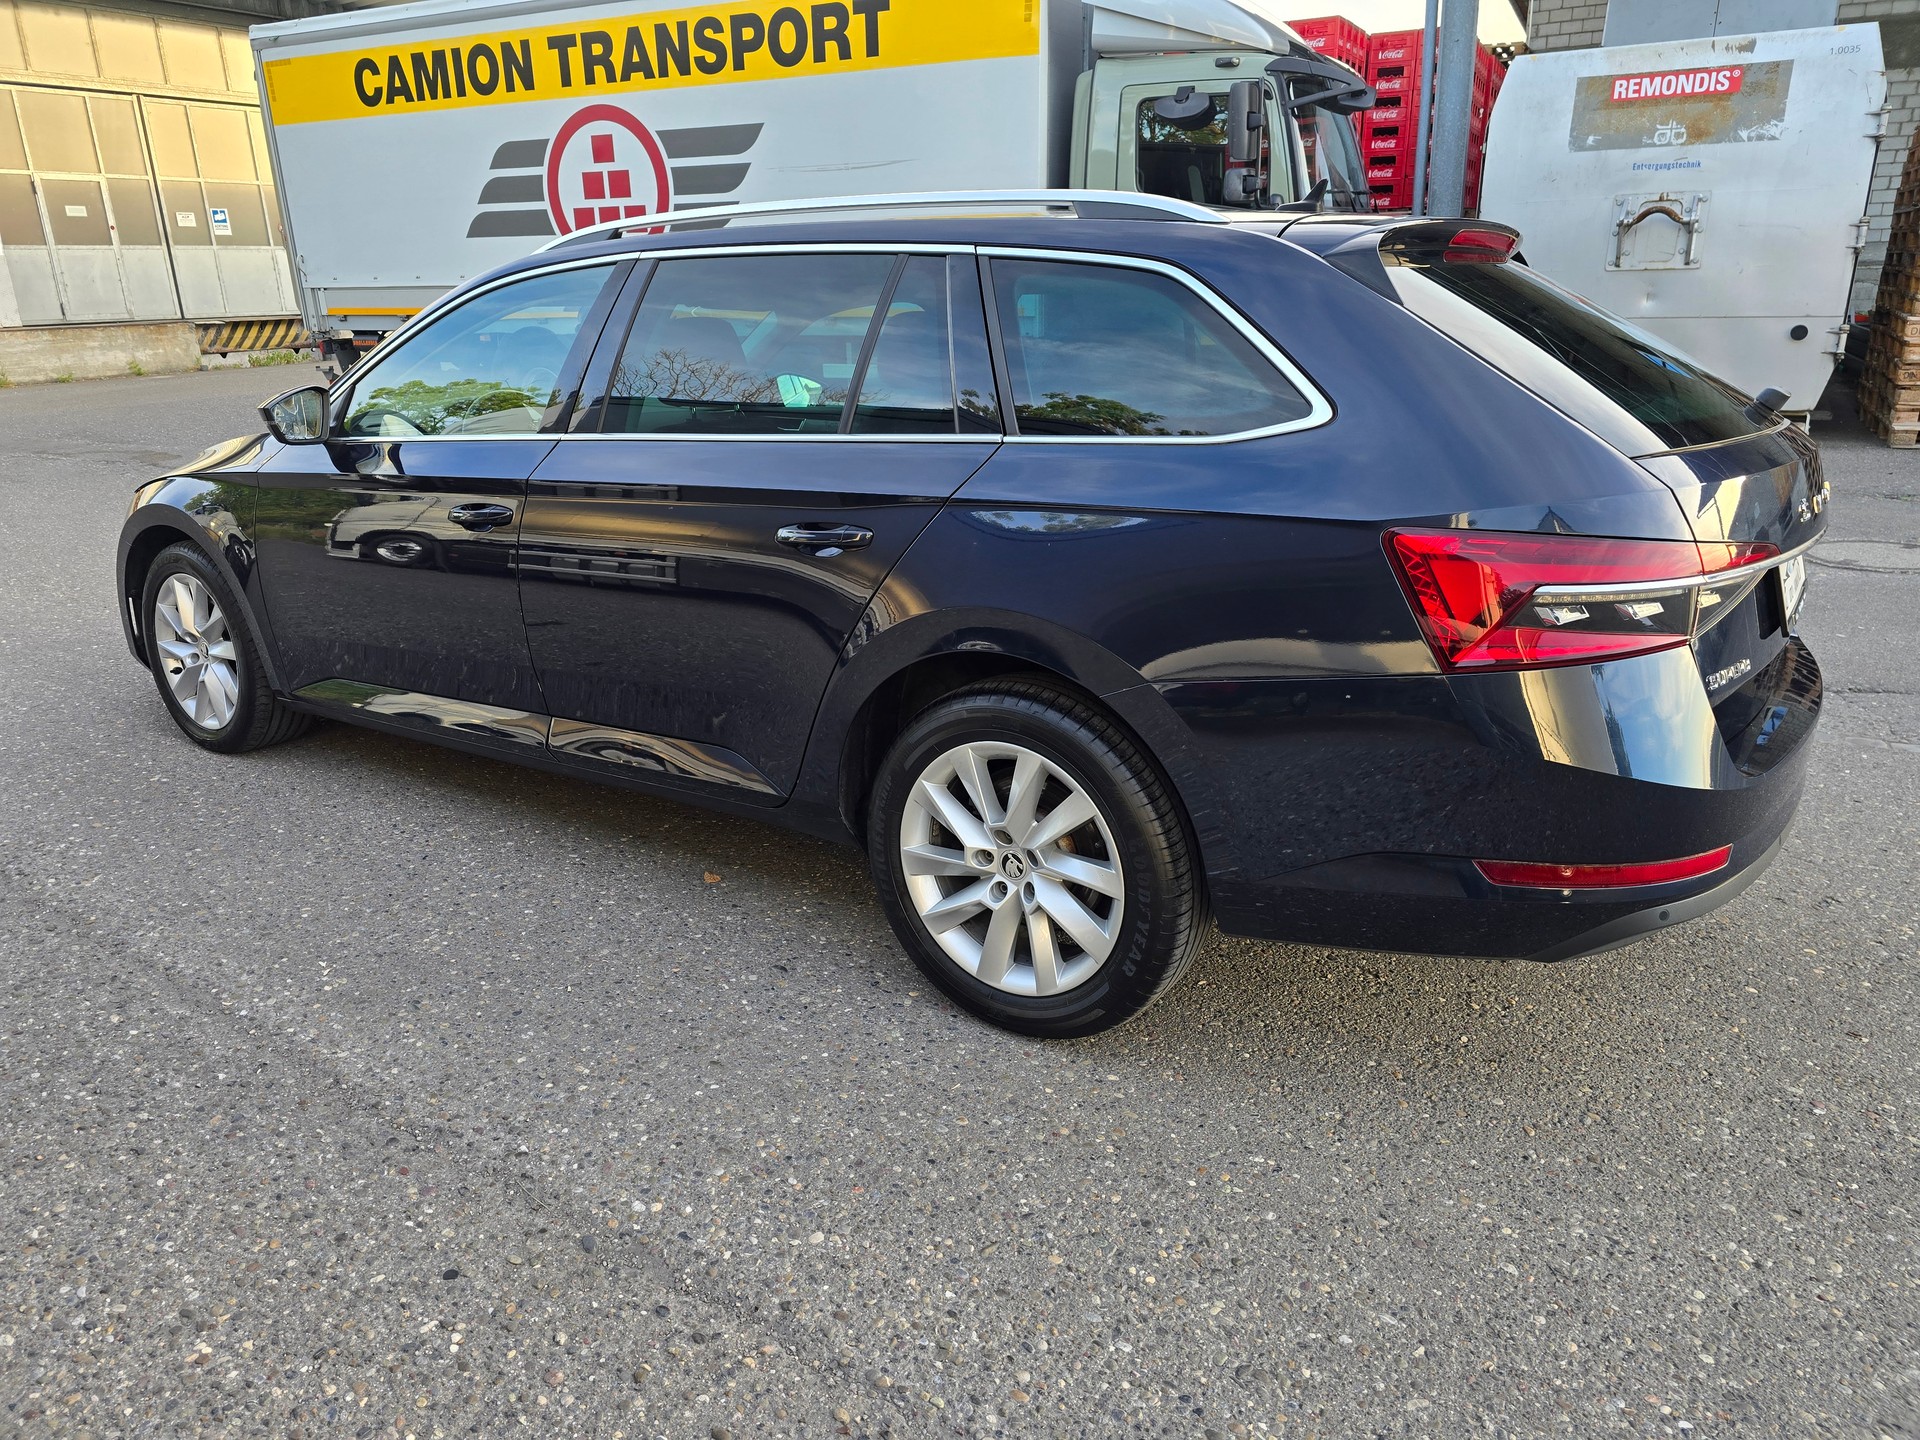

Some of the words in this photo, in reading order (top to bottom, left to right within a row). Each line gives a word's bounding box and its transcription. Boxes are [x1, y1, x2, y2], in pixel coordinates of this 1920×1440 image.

[354, 39, 535, 108] CAMION
[546, 0, 890, 88] TRANSPORT
[1830, 44, 1861, 55] 1.0035
